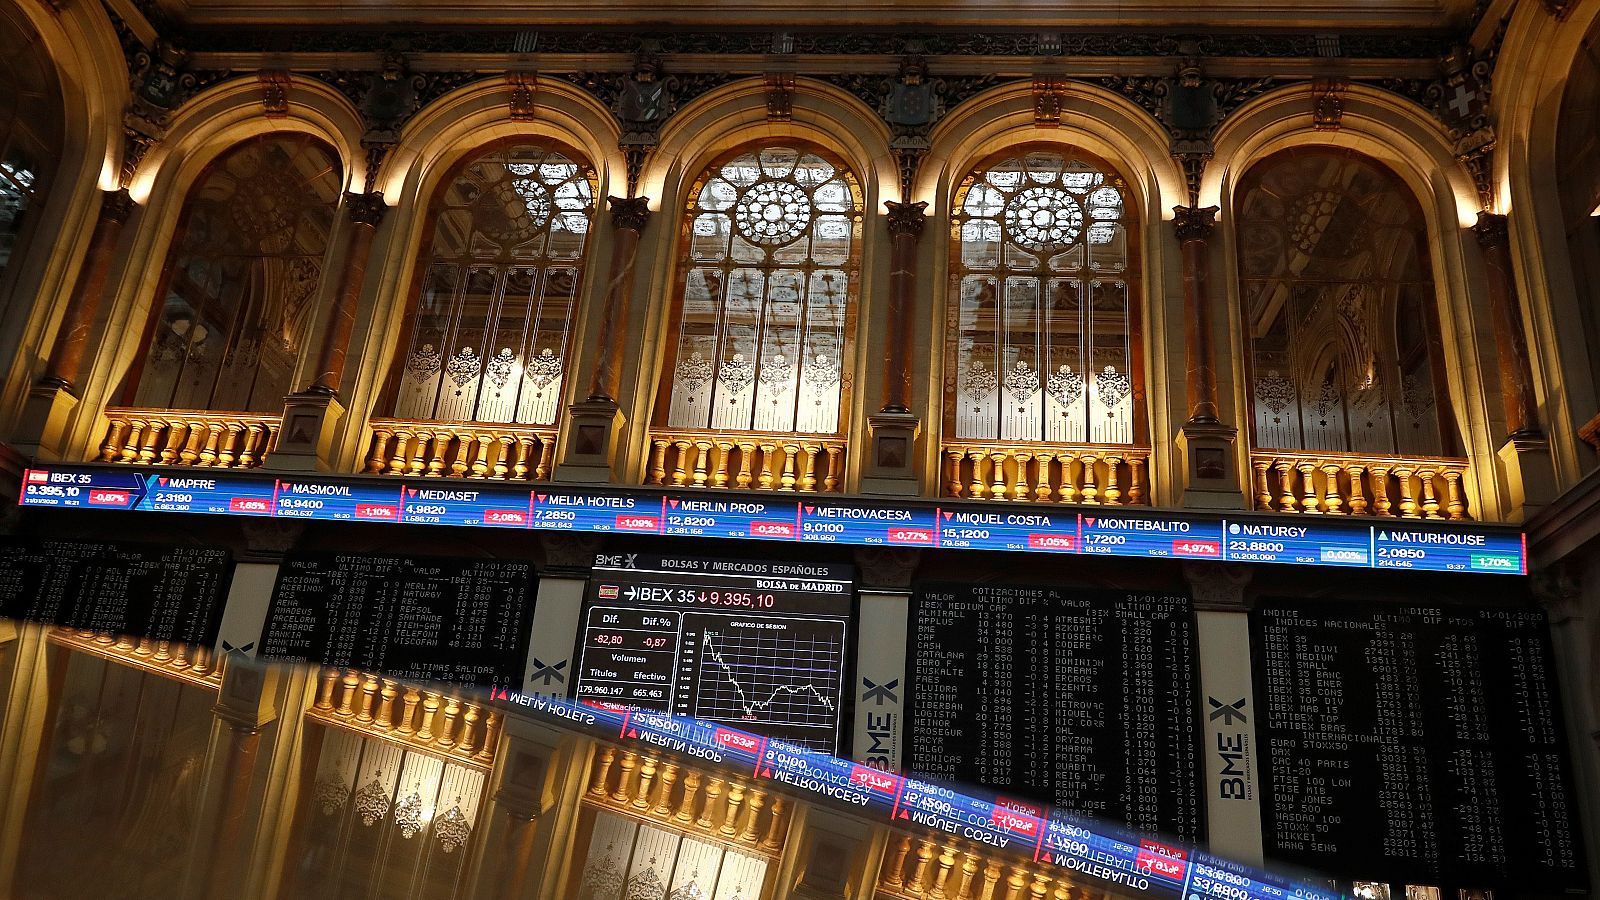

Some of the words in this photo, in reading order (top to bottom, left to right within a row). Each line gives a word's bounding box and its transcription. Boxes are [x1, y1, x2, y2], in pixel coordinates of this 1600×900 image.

[50, 473, 77, 483] IBEX
[78, 474, 92, 484] 35
[169, 478, 216, 490] MAPFRE
[27, 485, 80, 498] 9.395,10
[292, 484, 352, 496] MASMOVIL
[93, 493, 125, 503] -0,87%
[419, 489, 480, 502] MEDIASET
[234, 502, 265, 510] -1,65%
[279, 499, 324, 509] 18,9400
[548, 495, 585, 506] MELIA
[587, 496, 635, 508] HOTELS
[361, 508, 391, 516] -1,10%
[405, 504, 446, 515] 4,9820
[681, 501, 727, 513] MERLIN
[730, 503, 768, 514] PROP.
[488, 513, 522, 522] -2,08%
[535, 510, 576, 520] 7,2850
[817, 507, 913, 520] METROVACESA
[621, 519, 653, 528] -1,09%
[668, 516, 715, 527] 12,8200
[956, 513, 1004, 526] MIQUEL
[1007, 514, 1051, 527] COSTA
[1098, 518, 1190, 532] MONTEBALITO
[754, 526, 790, 535] -0,23%
[803, 523, 844, 533] 9,0100
[1243, 525, 1307, 537] NATURGY
[893, 532, 928, 541] -0,77%
[943, 529, 990, 539] 15,1200
[1391, 531, 1485, 546] NATURHOUSE
[1034, 537, 1069, 547] -1,05%
[1084, 534, 1126, 545] 1,7200
[1177, 543, 1215, 553] -4,97%
[1229, 541, 1284, 552] 23,8800
[174, 548, 225, 557] 31/01/2020
[1230, 552, 1276, 560] 10.208.090
[1327, 550, 1361, 560] 0,00%
[1378, 548, 1425, 559] 2,0950
[291, 561, 318, 569] VALOR
[336, 556, 399, 565] COTIZACIONES
[474, 563, 529, 572] 31/01/2020
[595, 554, 622, 566] BME
[1479, 557, 1512, 567] 1,70%
[661, 559, 699, 569] BOLSAS
[702, 561, 709, 570] Y
[712, 561, 768, 573] MERCADOS
[772, 563, 829, 576] ESPAÑOLES
[281, 576, 320, 585] ACCIONA
[280, 583, 323, 592] ACERINOX
[404, 582, 438, 590] MERLIN
[756, 580, 787, 590] BOLSA
[801, 581, 843, 592] MADRID
[279, 591, 295, 599] ACS
[403, 590, 442, 599] NATURGY
[636, 586, 673, 602] IBEX
[677, 589, 696, 603] 35
[710, 592, 774, 609] 9.395,10
[972, 587, 1043, 597] COTIZACIONES
[1049, 590, 1061, 598] AL
[1128, 595, 1187, 604] 31/01/2020
[277, 599, 299, 607] AENA
[274, 607, 313, 615] AMADEUS
[400, 605, 432, 614] REPSOL
[918, 609, 966, 618] ALMIRALL
[398, 613, 442, 623] SANTANDE
[602, 615, 620, 624] Dif.
[642, 617, 671, 626] Dif.%
[918, 618, 954, 626] APPLUS
[1276, 618, 1318, 626] INDICES
[1324, 620, 1387, 630] NACIONALES
[269, 631, 301, 639] BANKIA
[395, 629, 439, 638] TELEFONI
[393, 637, 438, 646] VISCOFAN
[594, 635, 623, 645] -82,80
[643, 638, 666, 648] -0,87
[917, 651, 965, 660] CATALANA
[1055, 649, 1073, 657] DIA
[612, 654, 646, 663] Volumen
[634, 671, 666, 680] Efectivo
[916, 668, 964, 677] EUSKALTE
[1055, 675, 1092, 684] ERCROS
[579, 686, 624, 695] 179.960.147
[633, 689, 663, 698] 665.463
[914, 727, 963, 737] PROSEGUR
[866, 712, 891, 770] BME
[914, 736, 944, 744] SACYR
[1303, 732, 1399, 744] INTERNACIONALES
[1055, 745, 1093, 754] PHARMA
[1272, 748, 1291, 756] DAX
[913, 754, 962, 763] TECNICAS
[1055, 754, 1087, 762] PRISA
[1272, 757, 1291, 765] CAC
[1298, 758, 1311, 767] 40
[1317, 760, 1350, 769] PARIS
[1217, 732, 1246, 800] BME
[1055, 790, 1080, 799] ROVI
[1277, 831, 1316, 841] NIKKEI
[1277, 841, 1304, 850] HANG
[1310, 842, 1337, 853] SENG
